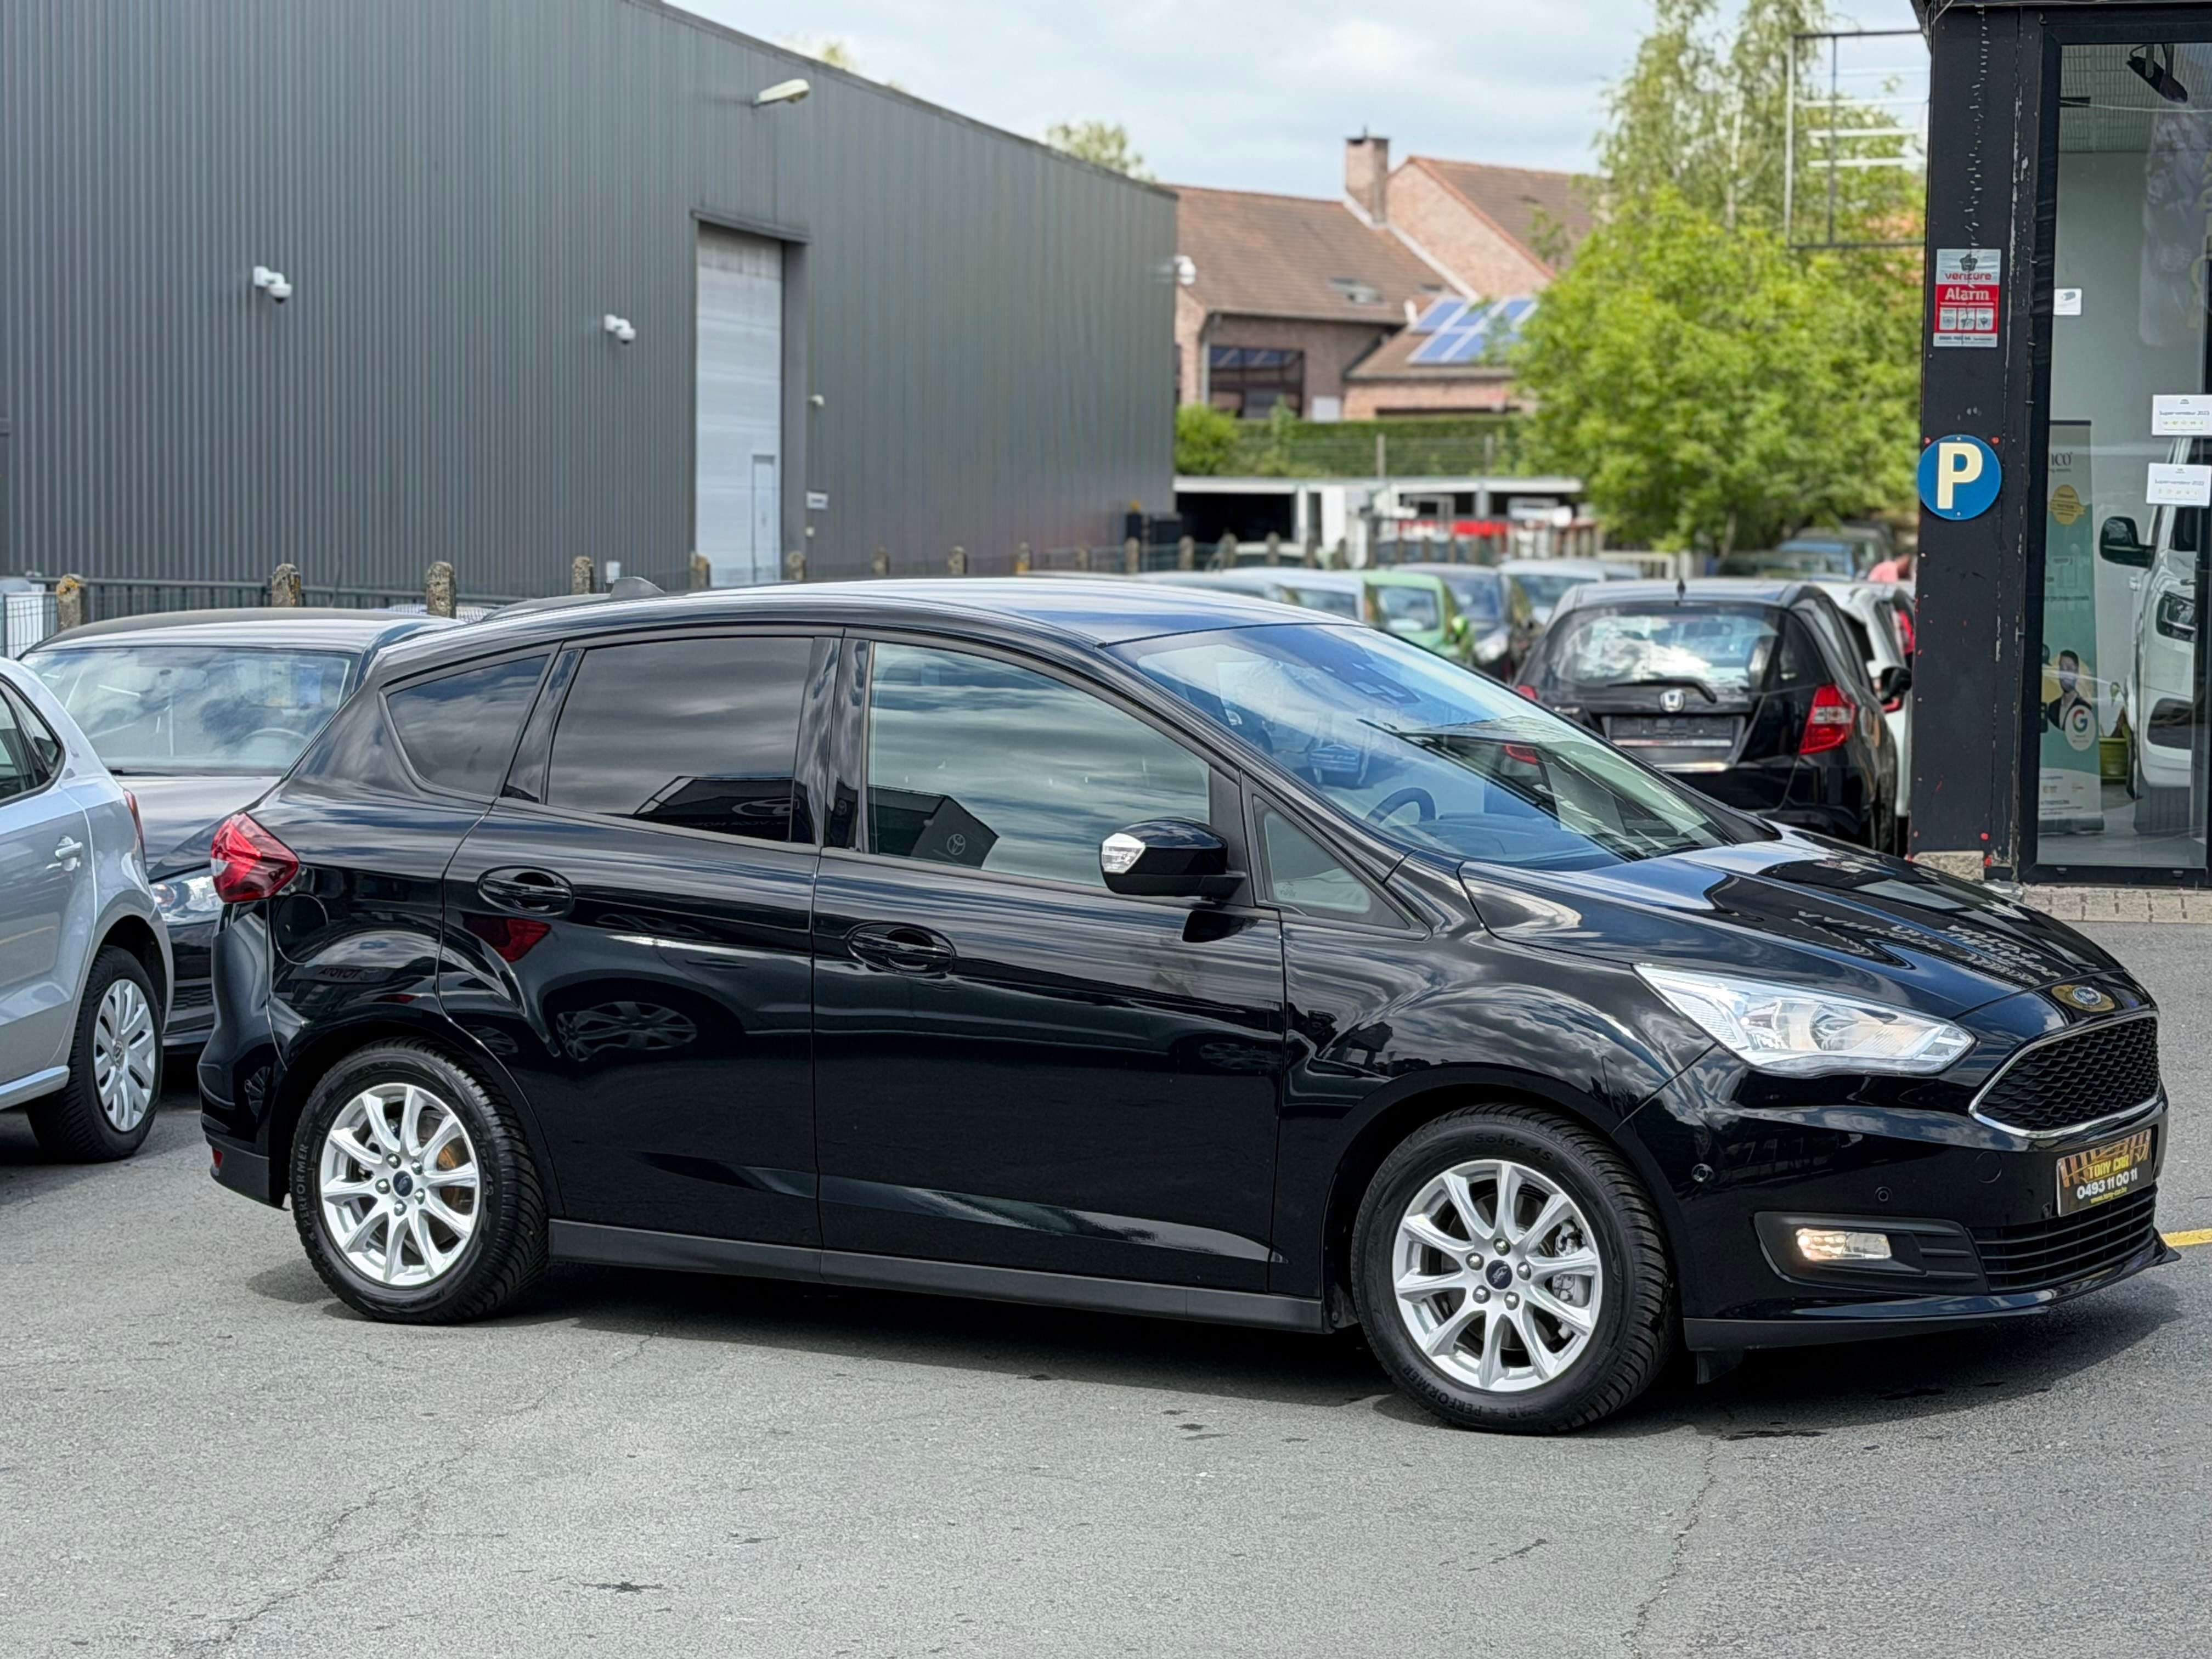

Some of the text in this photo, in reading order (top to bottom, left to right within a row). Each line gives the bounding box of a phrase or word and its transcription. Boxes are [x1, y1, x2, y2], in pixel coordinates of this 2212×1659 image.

[1945, 287, 1989, 301] Alarm
[1937, 442, 1983, 510] P
[2088, 1154, 2129, 1179] TONY CAR
[2076, 1167, 2138, 1199] 0493 11 00 11
[1402, 1364, 1483, 1417] PERFORMER
